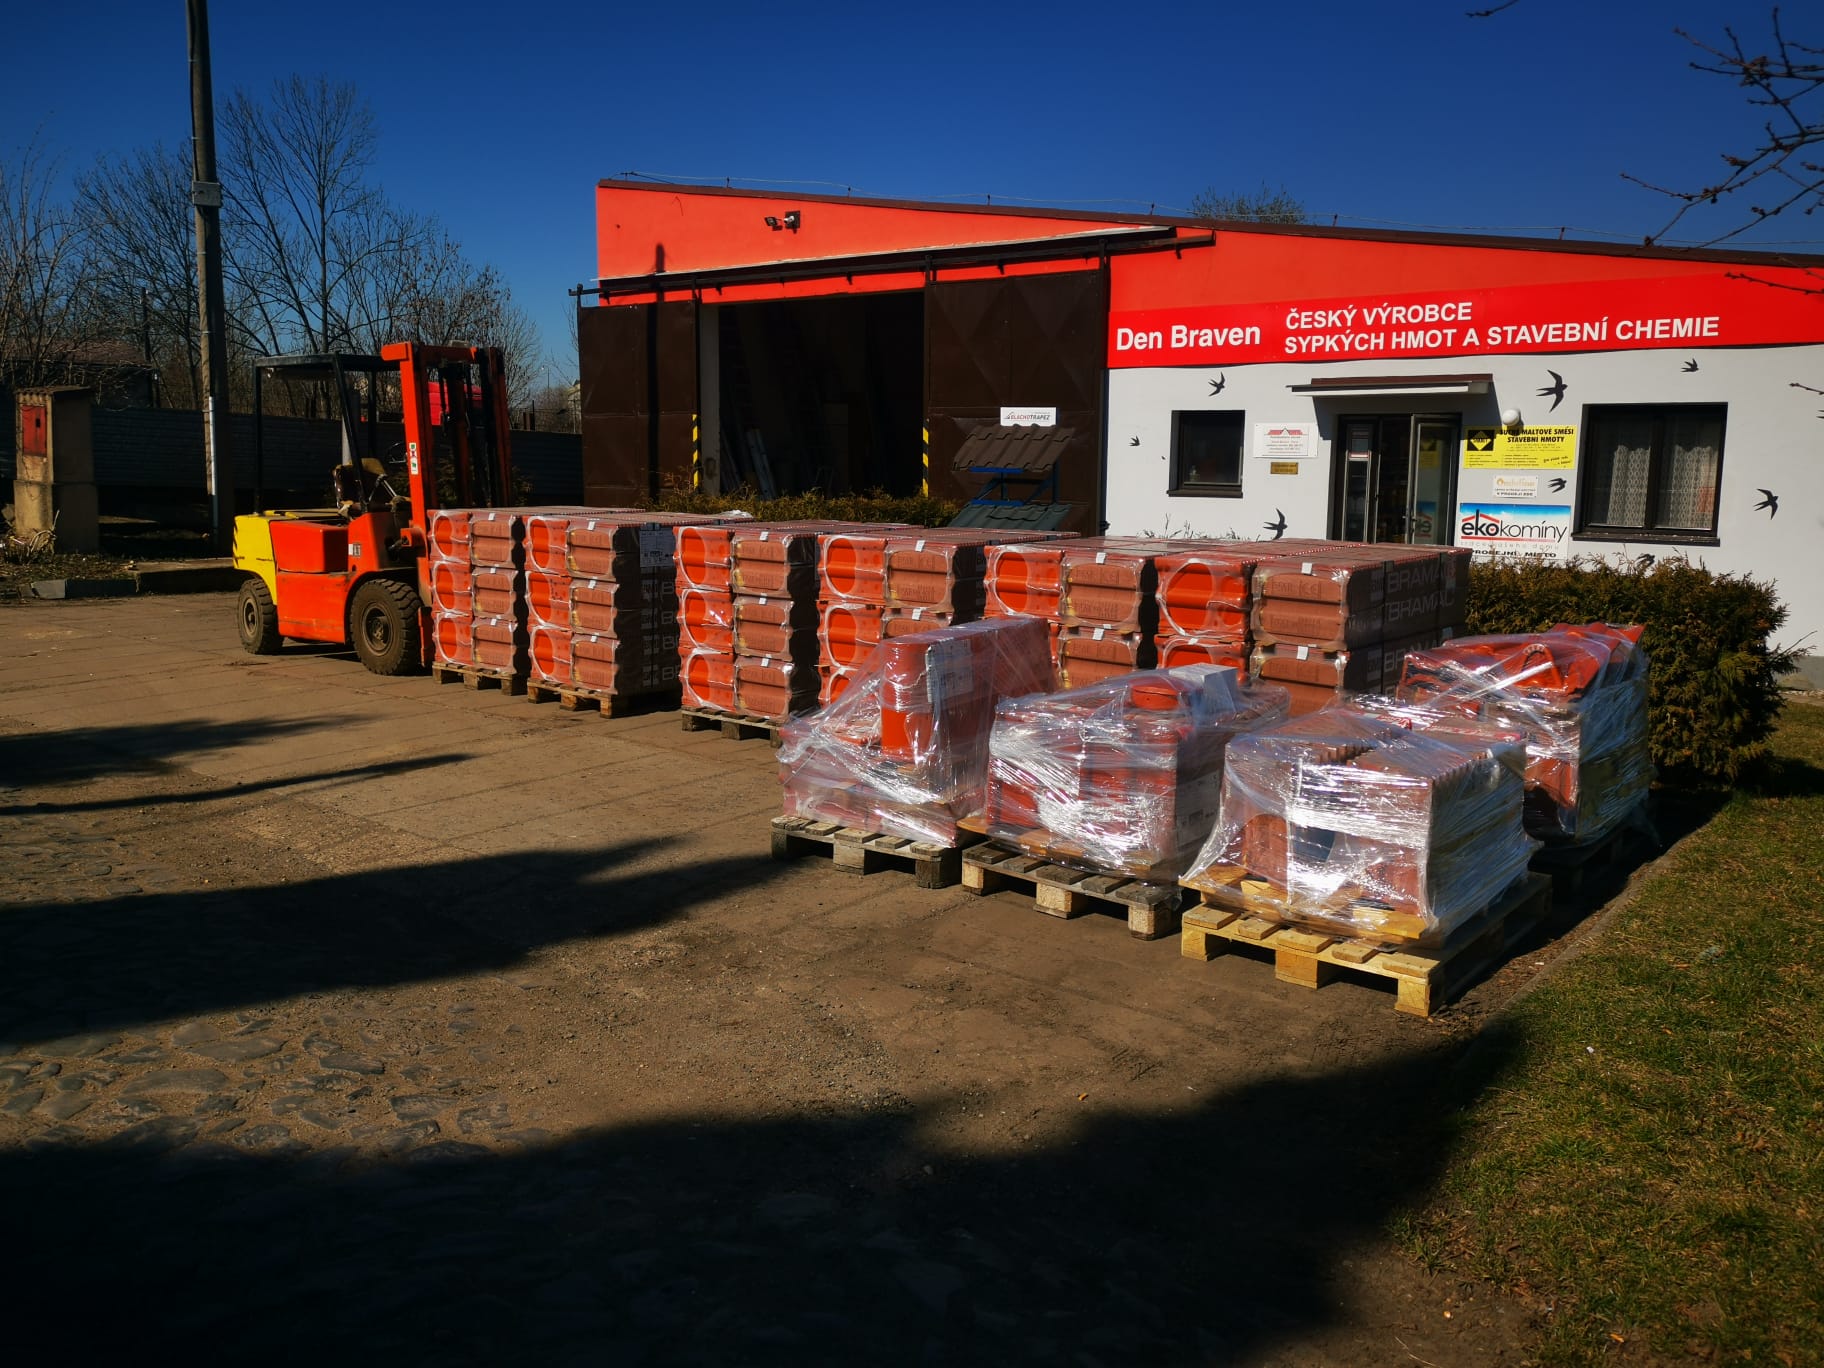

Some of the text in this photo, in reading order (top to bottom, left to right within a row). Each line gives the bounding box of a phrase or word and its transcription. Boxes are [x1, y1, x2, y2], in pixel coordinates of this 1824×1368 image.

[1286, 301, 1472, 330] ČESKÝ VÝROBCE
[1117, 324, 1261, 350] Den Braven
[1285, 316, 1720, 354] SYPKÝCH HMOT A STAVEBNÍ CHEMIE
